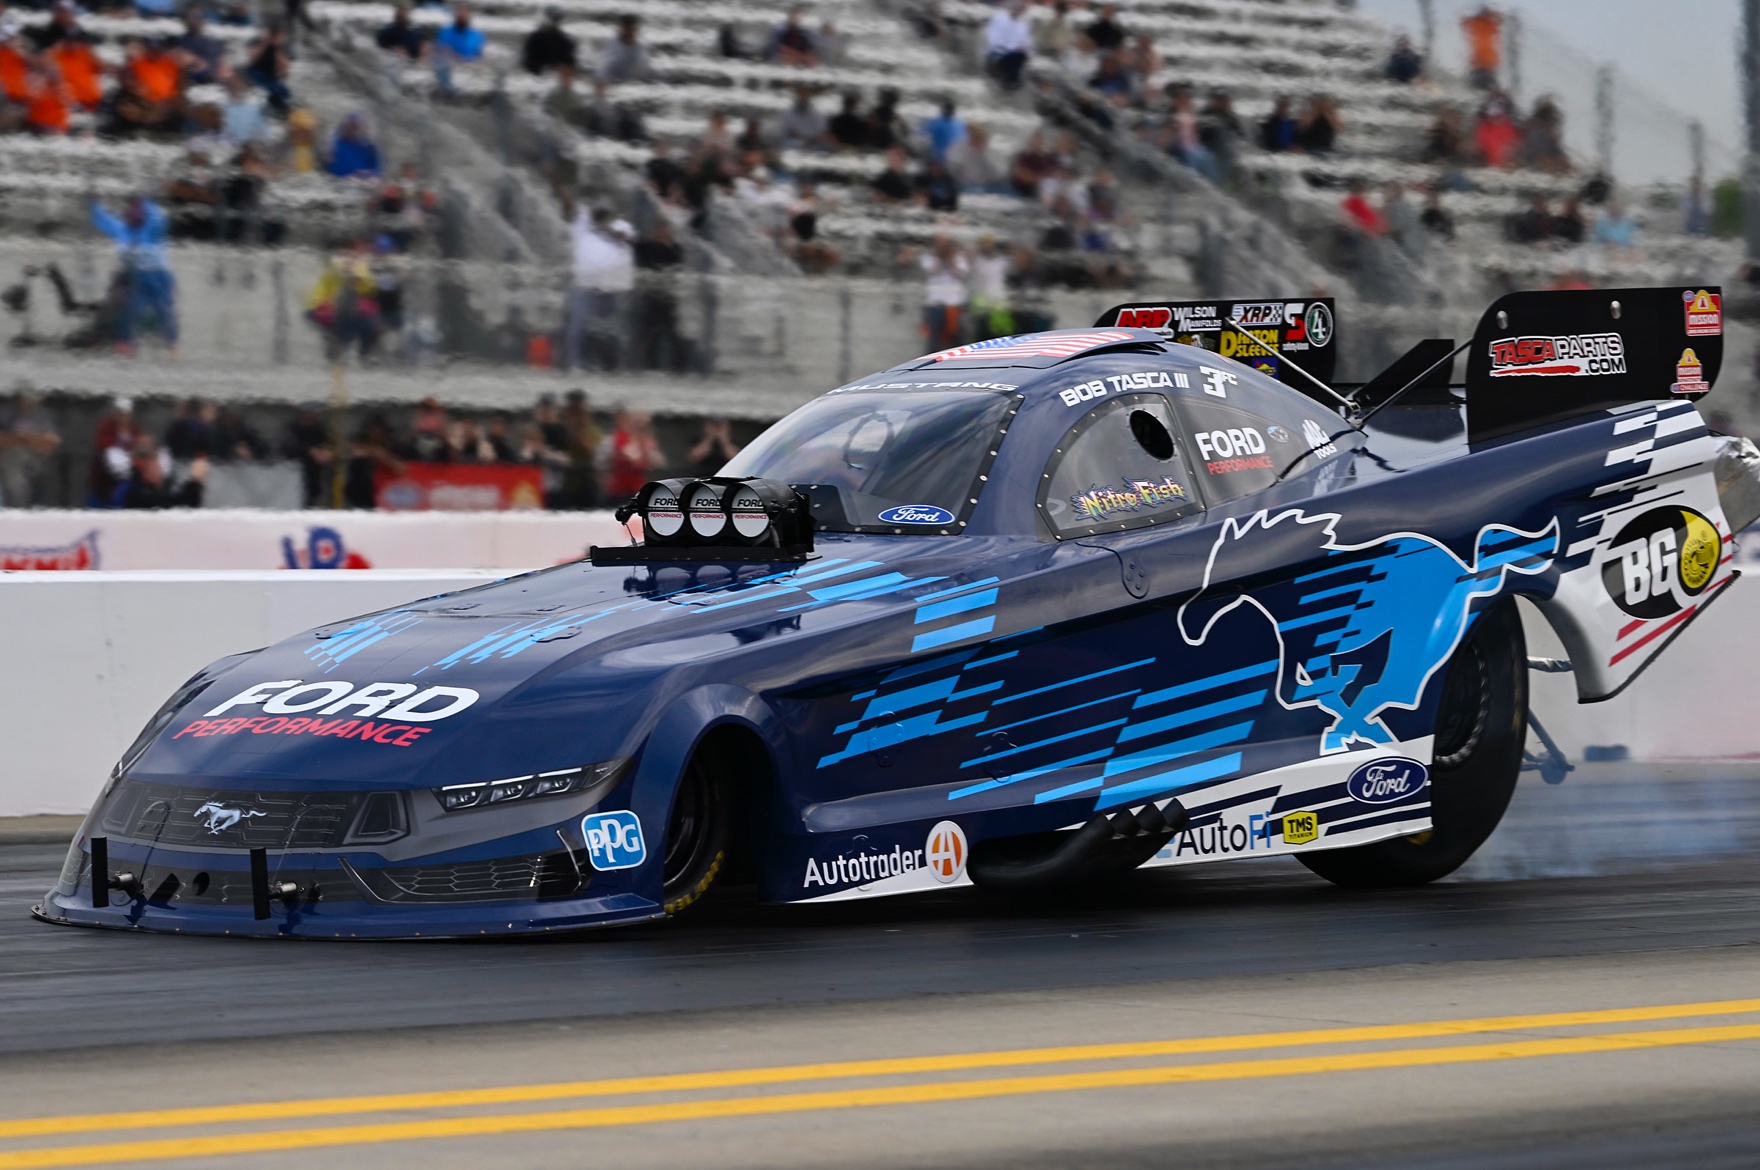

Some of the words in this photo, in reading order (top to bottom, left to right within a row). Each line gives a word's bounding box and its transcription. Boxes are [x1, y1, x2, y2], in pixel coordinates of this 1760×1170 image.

[1115, 307, 1172, 328] ARP
[1172, 306, 1217, 321] WILSON
[1178, 317, 1222, 331] MANIFOLDS
[1239, 305, 1273, 323] XRP
[1491, 335, 1622, 365] TASCAPARTS
[1585, 358, 1625, 374] .COM
[826, 381, 1020, 395] MUSTANG
[1058, 379, 1108, 407] BOB
[1106, 371, 1174, 392] TASCA
[1174, 372, 1190, 389] III
[1195, 427, 1267, 461] FORD
[1313, 443, 1338, 460] TOOLS
[1206, 455, 1275, 475] PERFORMANCE
[737, 499, 764, 507] FORD
[1077, 488, 1138, 517] Nitro
[1132, 478, 1185, 504] Fish
[891, 507, 941, 522] Ford
[1618, 526, 1678, 606] BG
[202, 679, 481, 722] FORD
[172, 716, 433, 747] PERFORMANCE
[1361, 764, 1411, 798] Ford
[1176, 810, 1271, 857] AutoFi
[1287, 816, 1314, 833] TMS
[586, 818, 641, 863] PPG
[1288, 831, 1314, 840] TITANIUM
[803, 844, 923, 888] Autotrader
